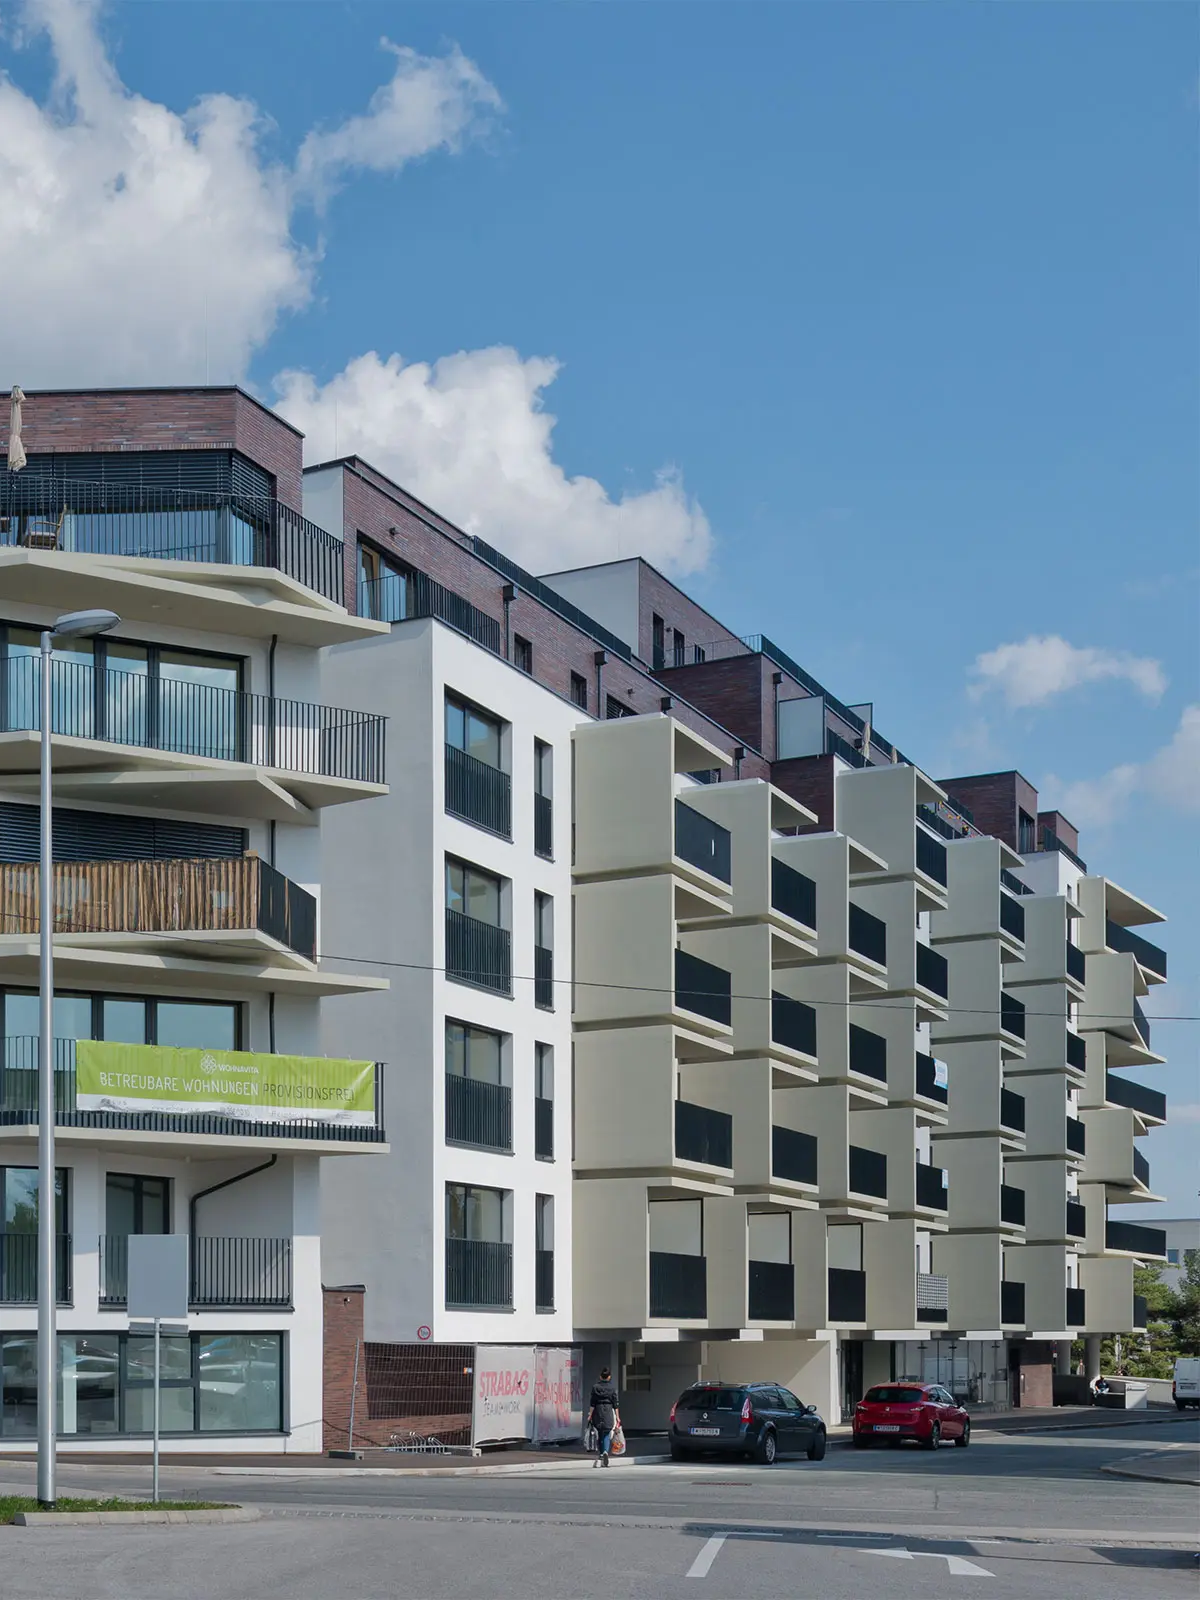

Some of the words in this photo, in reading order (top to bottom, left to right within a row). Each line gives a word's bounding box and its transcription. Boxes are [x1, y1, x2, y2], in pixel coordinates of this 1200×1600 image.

[218, 1064, 259, 1074] WOHNAVITA
[99, 1071, 179, 1092] BETREUBARE
[182, 1078, 259, 1096] WOHNUNGEN
[479, 1369, 530, 1398] STRABAG
